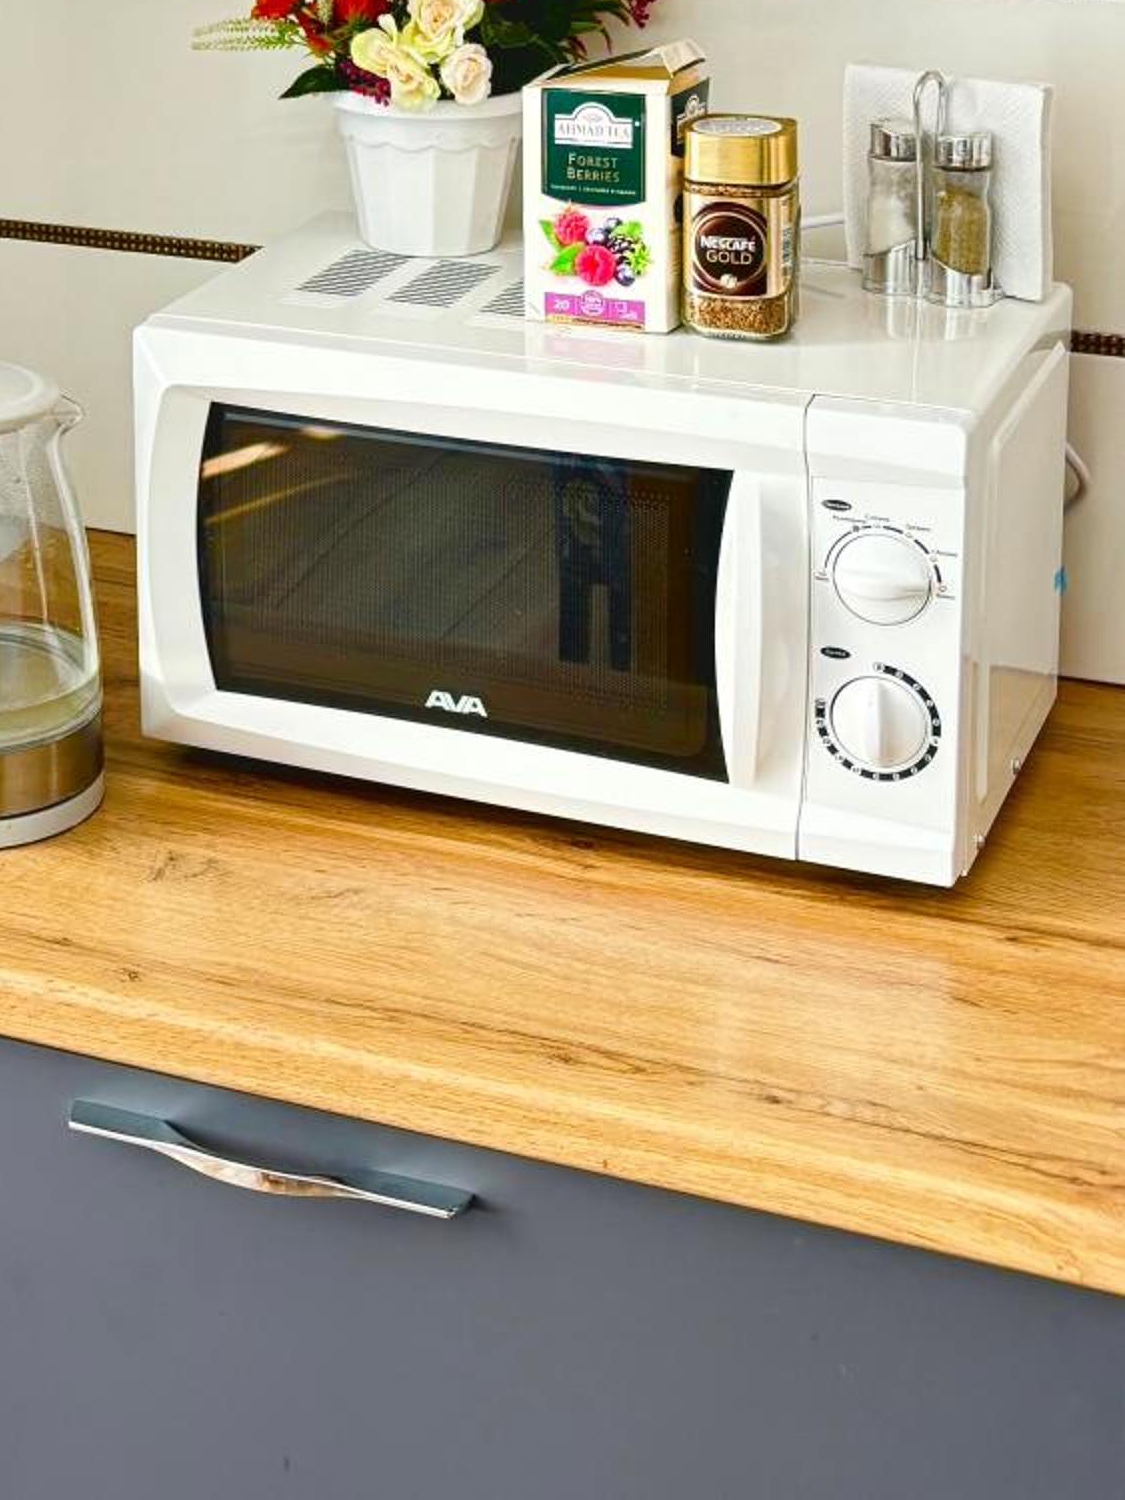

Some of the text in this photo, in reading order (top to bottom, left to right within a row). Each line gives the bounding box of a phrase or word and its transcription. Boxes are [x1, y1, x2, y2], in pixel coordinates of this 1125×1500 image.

[557, 122, 629, 138] AHMAD TEA
[568, 152, 619, 169] FOREST
[566, 166, 620, 183] BERRIES
[706, 249, 753, 265] GOLD
[424, 690, 488, 718] AVA
